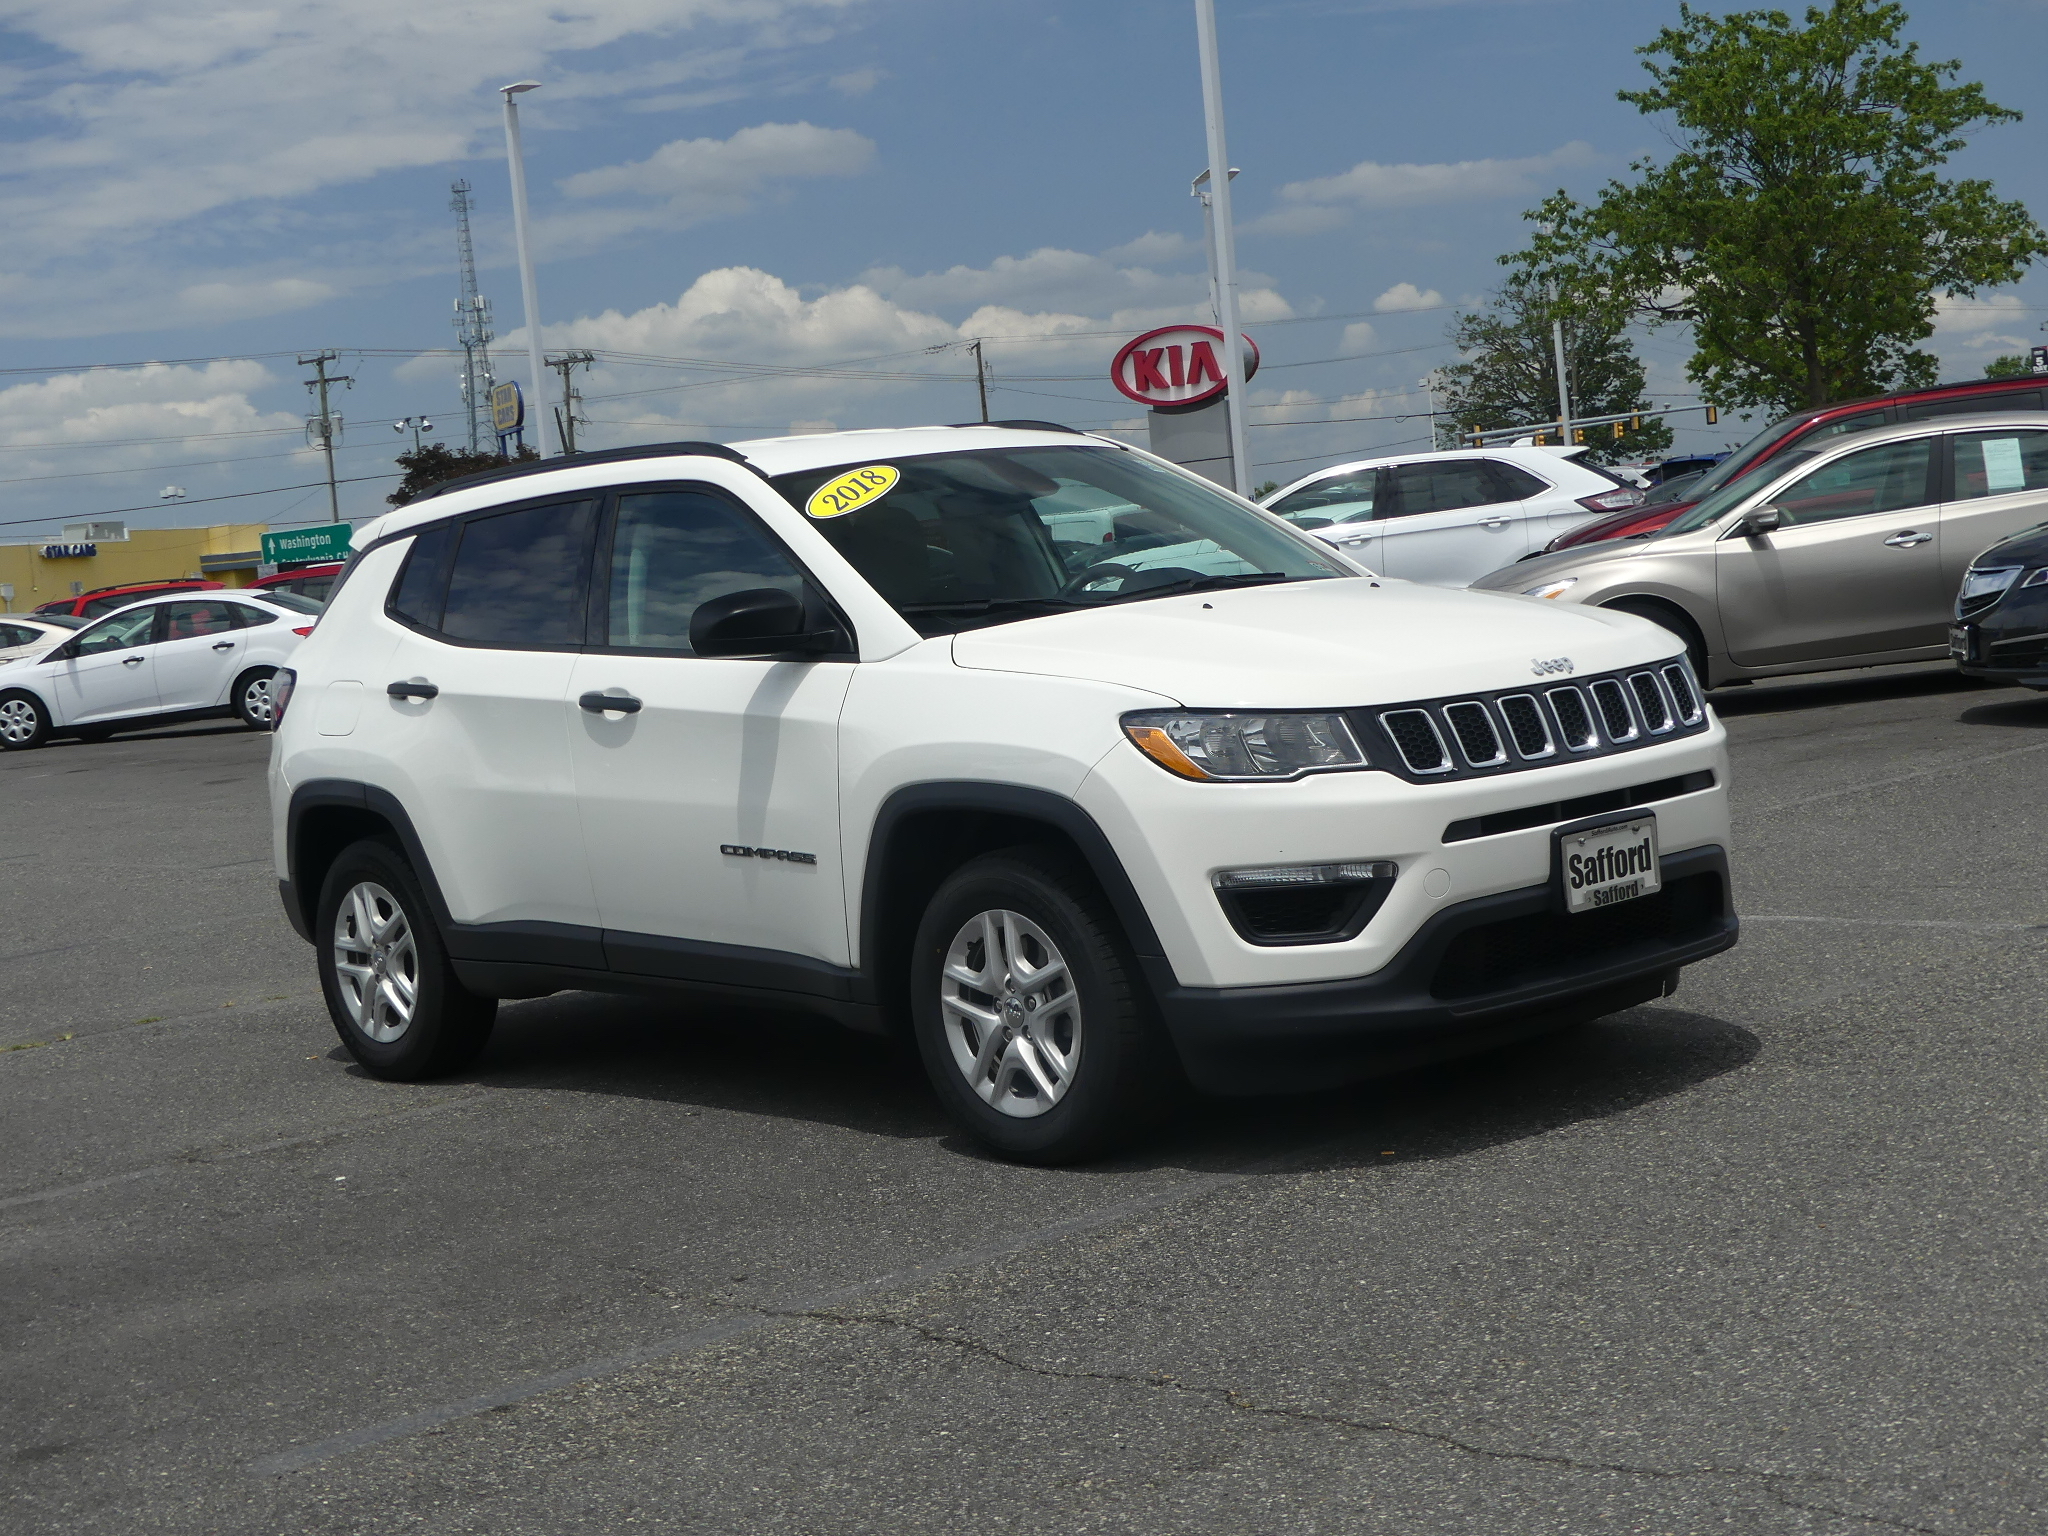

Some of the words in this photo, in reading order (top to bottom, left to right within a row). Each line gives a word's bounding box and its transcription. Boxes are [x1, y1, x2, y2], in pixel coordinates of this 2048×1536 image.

[1131, 341, 1223, 391] KIA
[2035, 356, 2044, 366] 5
[496, 387, 512, 406] STAR
[497, 405, 514, 425] CARS
[822, 470, 887, 511] 2018
[44, 545, 70, 558] STAR
[71, 544, 97, 556] CARS
[280, 534, 332, 549] Washington
[1530, 656, 1574, 676] Jeep
[720, 844, 818, 865] COMPASS
[1569, 837, 1652, 889] Safford
[1593, 880, 1639, 906] Safford
